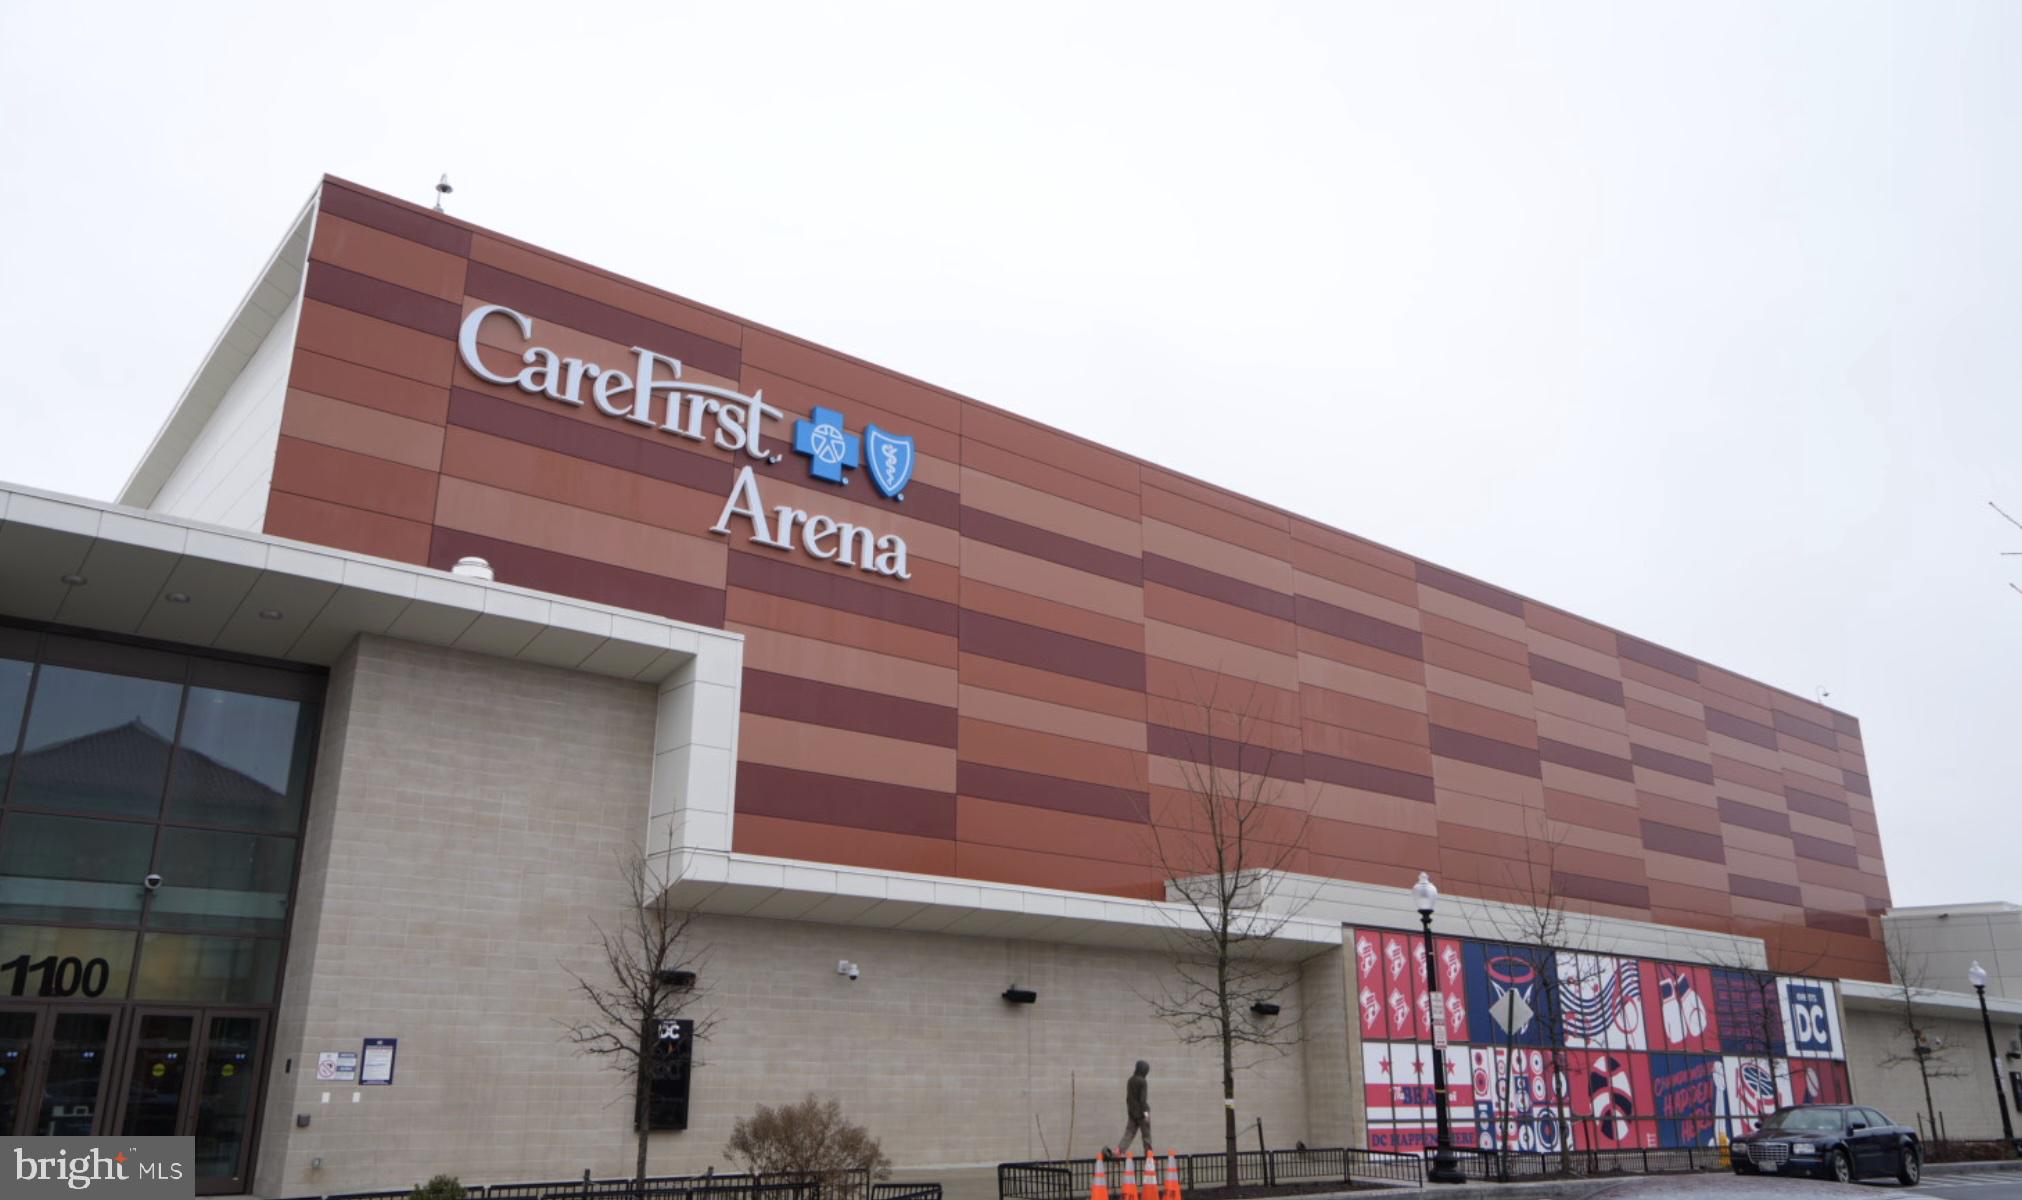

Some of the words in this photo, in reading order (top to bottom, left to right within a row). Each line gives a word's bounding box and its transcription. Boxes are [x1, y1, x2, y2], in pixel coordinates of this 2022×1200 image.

[709, 465, 912, 580] Arena
[1, 954, 110, 998] 1100
[1791, 1003, 1828, 1044] DC
